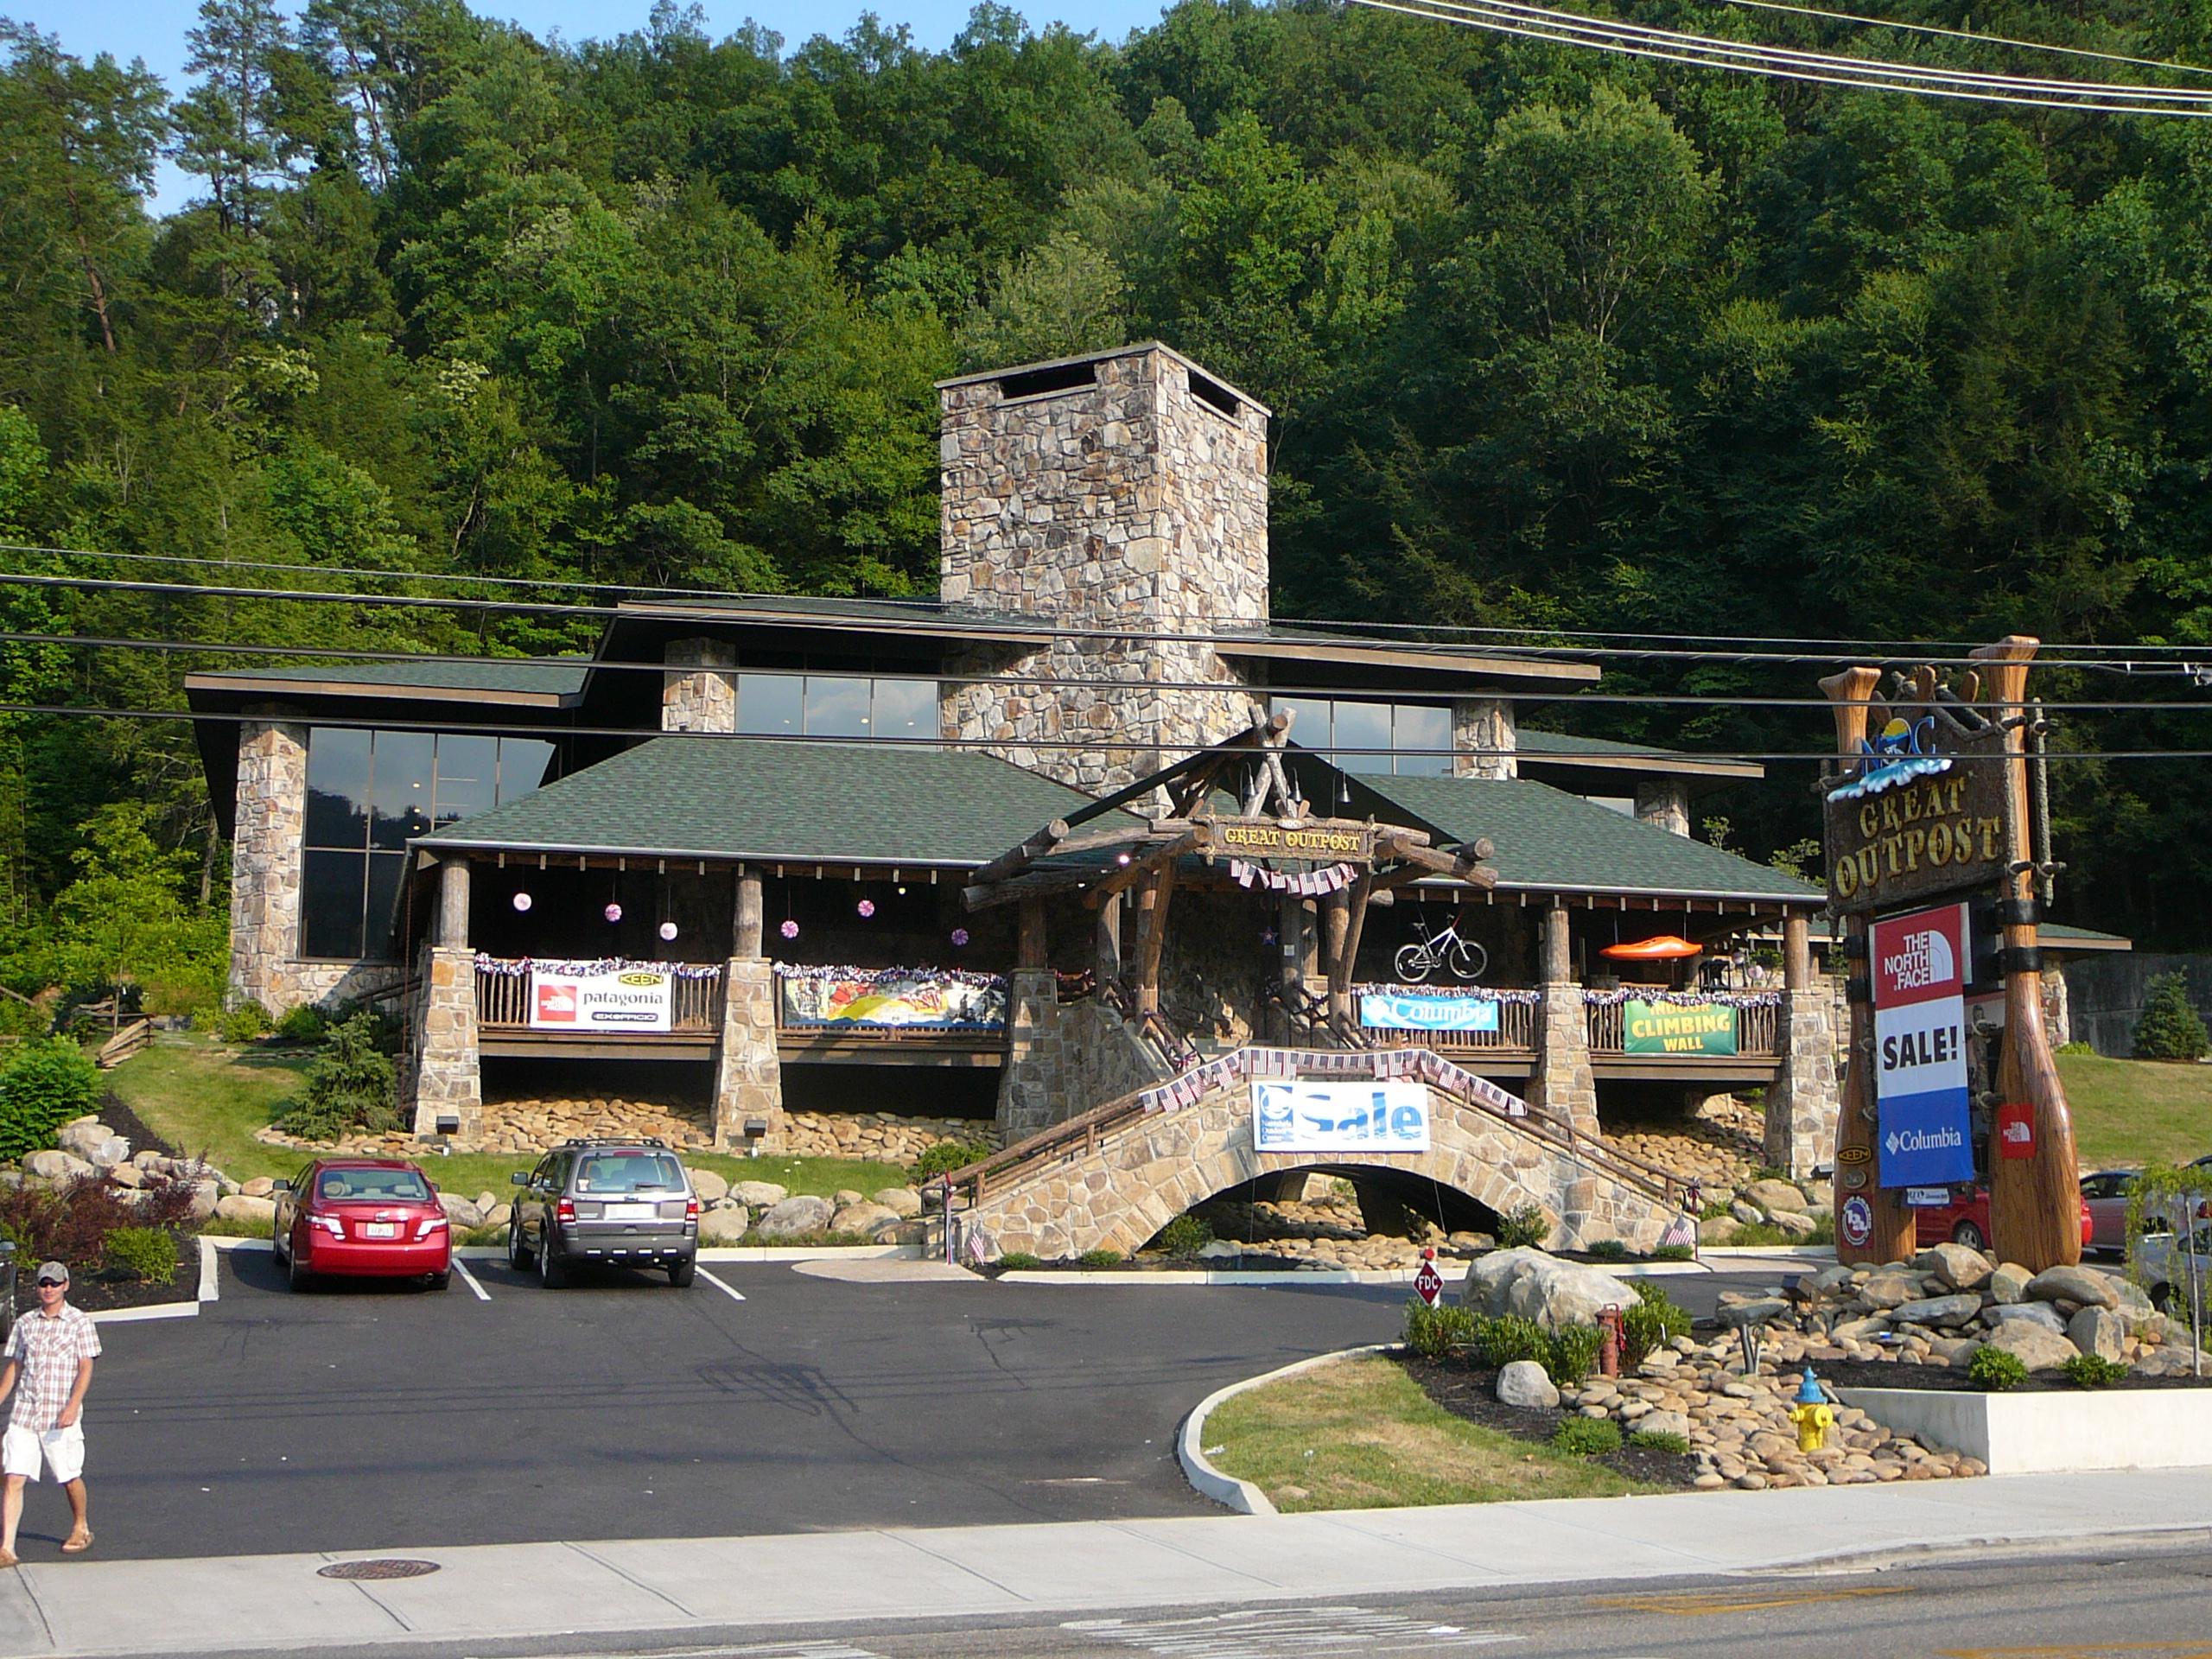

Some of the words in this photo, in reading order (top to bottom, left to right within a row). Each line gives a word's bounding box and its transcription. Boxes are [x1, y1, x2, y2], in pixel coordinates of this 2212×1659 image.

[1859, 777, 1966, 839] GREAT
[1224, 828, 1281, 846] GREAT
[1285, 832, 1361, 851] OUTPOST
[1835, 816, 2001, 898] OUTPOST
[1904, 931, 1929, 952] THE
[1885, 949, 1929, 976] NORTH
[620, 974, 664, 984] KEEN
[1897, 967, 1930, 990] FACE
[583, 992, 663, 1006] patagonia
[1392, 999, 1492, 1021] Columbia
[1631, 1014, 1731, 1038] CLIMBING
[1662, 1037, 1704, 1052] WALL
[1883, 1027, 1958, 1071] SALE!
[1298, 1091, 1423, 1141] Sale
[1900, 1127, 1962, 1151] Columbia
[1839, 1149, 1870, 1160] KEEN
[1418, 1274, 1439, 1290] FDC
